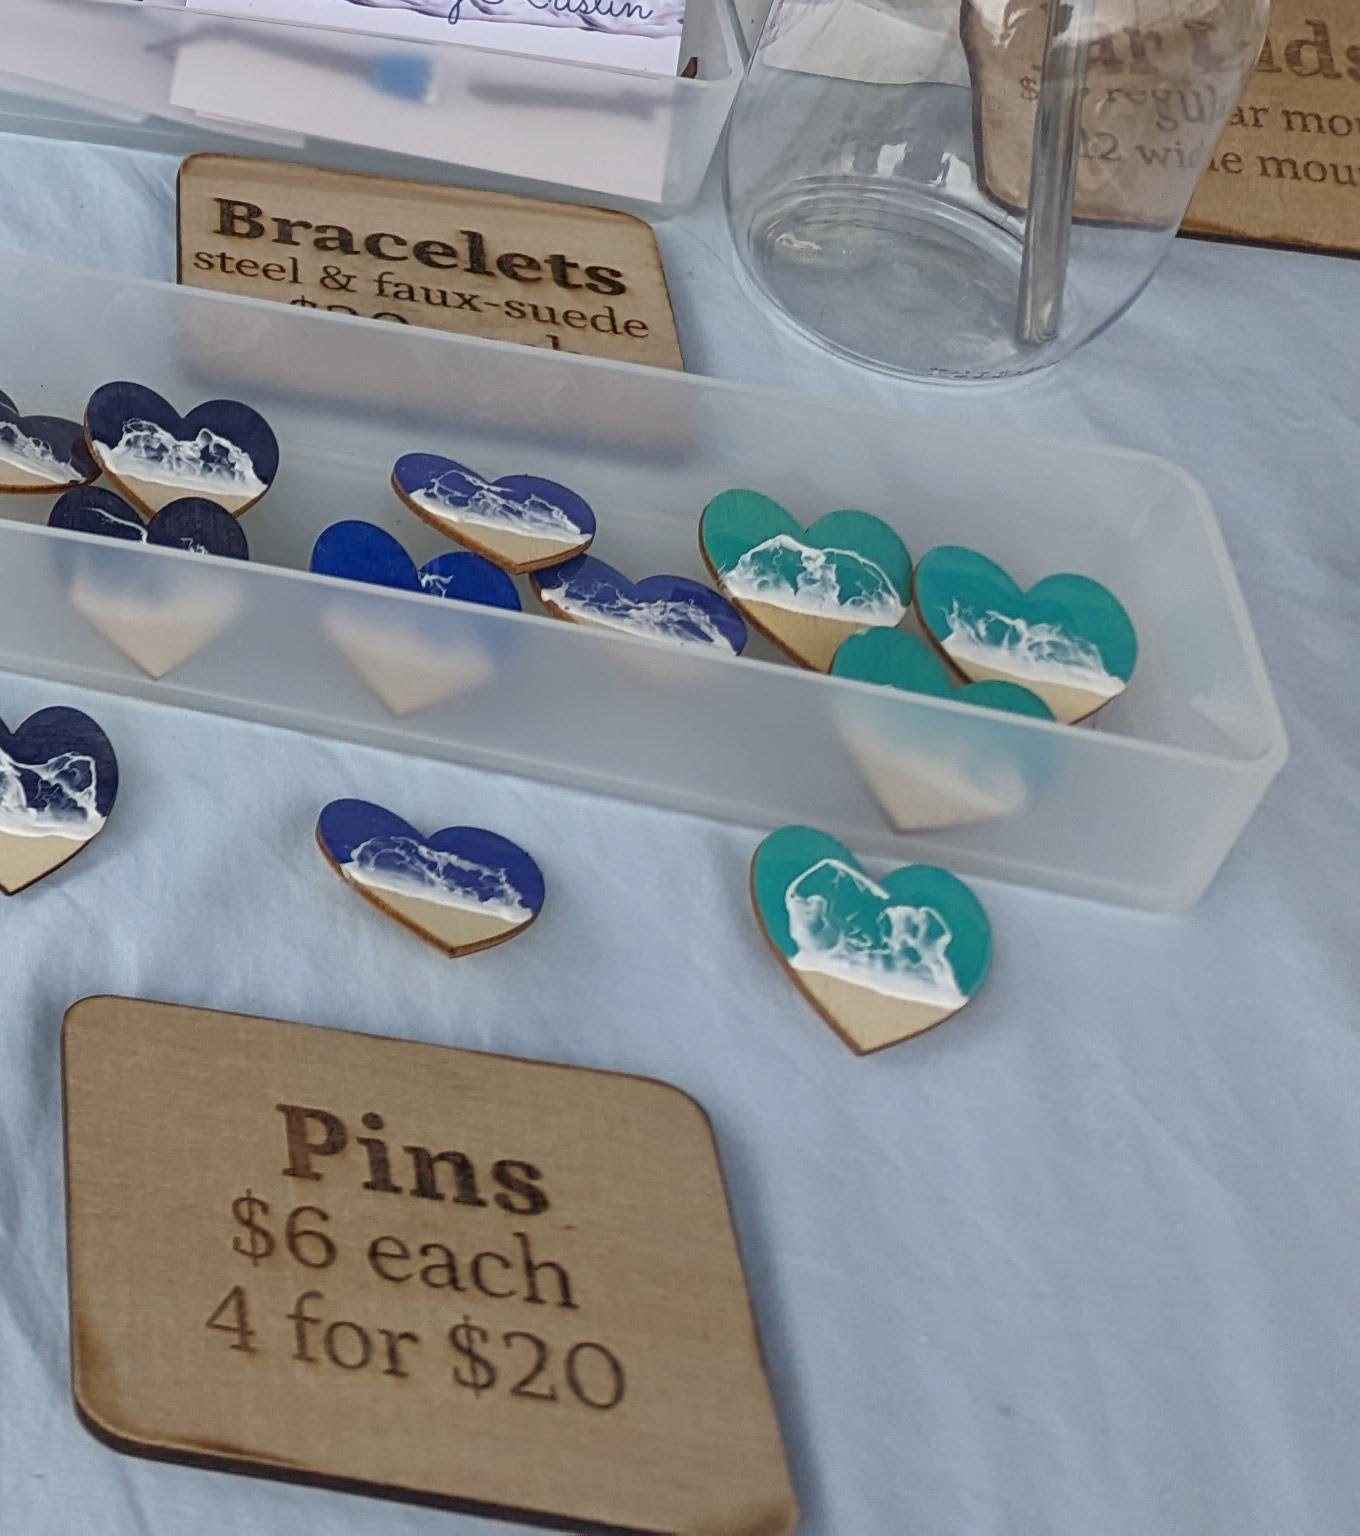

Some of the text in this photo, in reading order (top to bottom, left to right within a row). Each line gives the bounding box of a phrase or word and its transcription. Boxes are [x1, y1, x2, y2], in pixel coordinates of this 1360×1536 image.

[193, 247, 300, 285] steel
[320, 265, 357, 294] &
[374, 271, 649, 340] faux-suede
[212, 197, 627, 297] Bracelets
[275, 1102, 550, 1218] Pins
[231, 1190, 580, 1310] $6 each
[205, 1284, 627, 1411] 4 for $20
